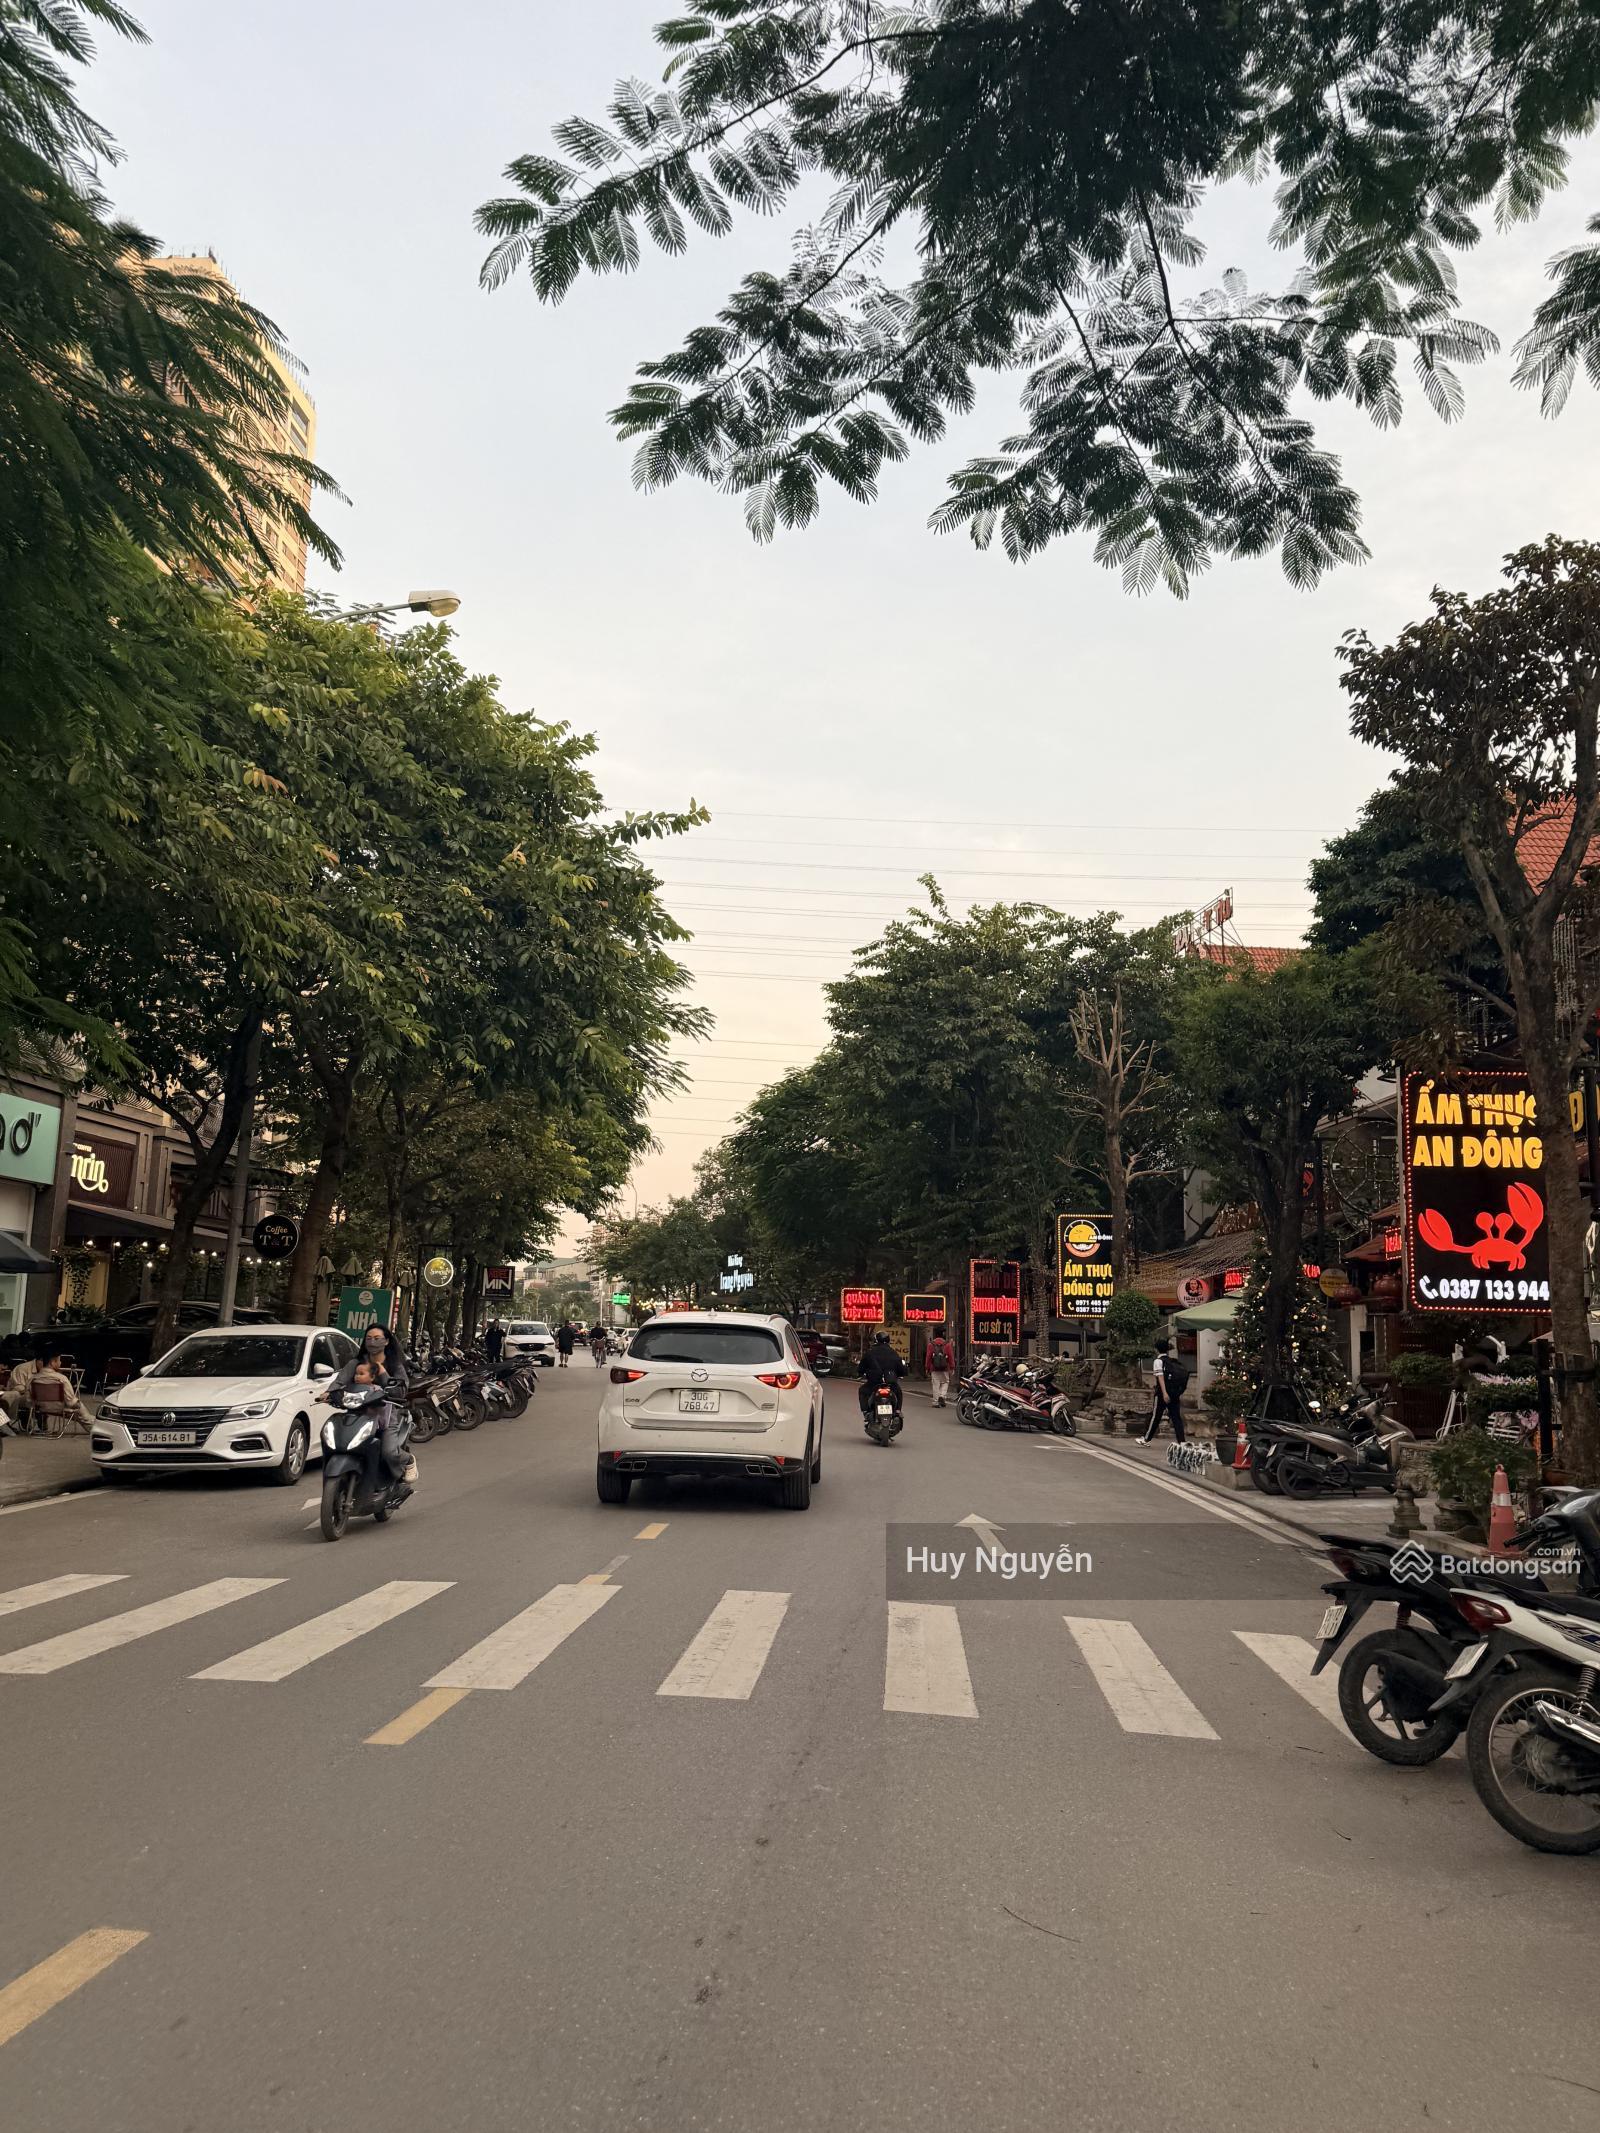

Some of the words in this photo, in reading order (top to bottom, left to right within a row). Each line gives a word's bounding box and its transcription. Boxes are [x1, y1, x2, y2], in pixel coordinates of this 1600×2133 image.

[1415, 1079, 1463, 1125] ẨM
[1413, 1135, 1454, 1167] AN
[1461, 1129, 1543, 1169] ĐÔNG
[265, 1225, 288, 1235] Coffee
[1096, 1282, 1113, 1297] QU
[1439, 1279, 1480, 1299] 0387
[1485, 1280, 1515, 1299] 133
[1518, 1281, 1550, 1301] 944
[347, 1309, 378, 1330] NHÀ
